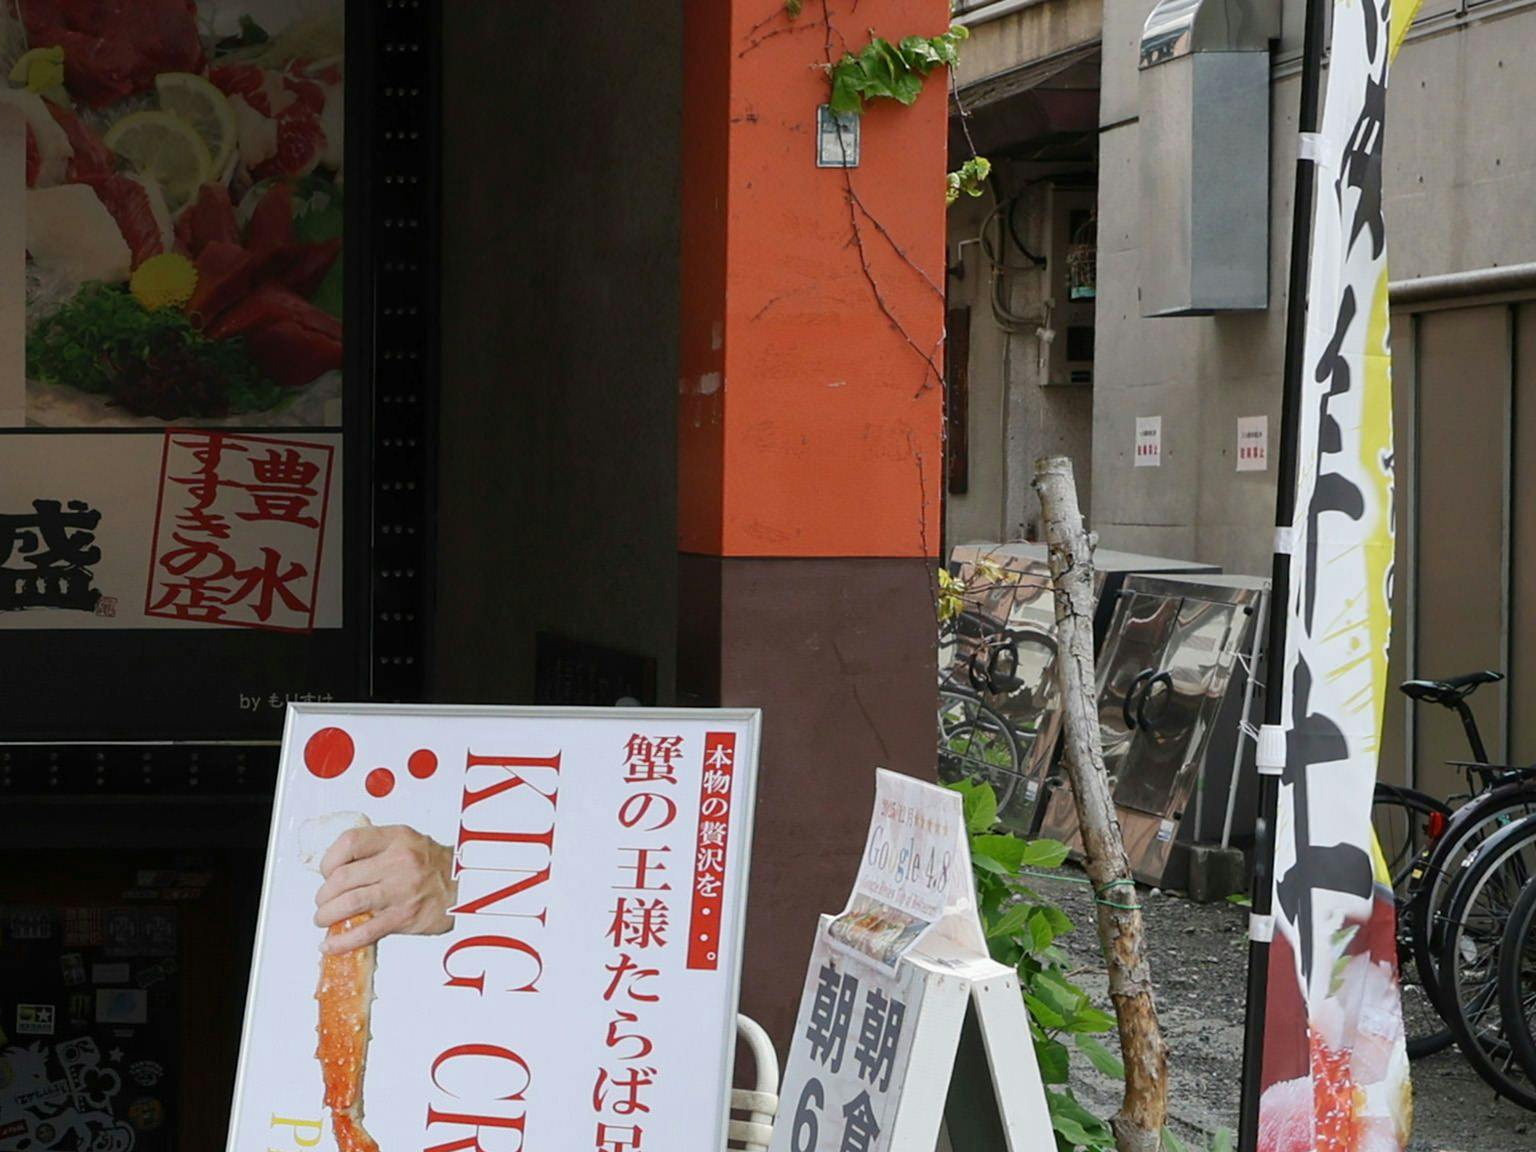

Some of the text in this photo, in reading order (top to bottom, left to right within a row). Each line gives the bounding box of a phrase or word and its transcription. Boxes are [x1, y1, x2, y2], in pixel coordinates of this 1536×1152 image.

[148, 435, 248, 623] すすきの店
[223, 448, 322, 622] 豊水
[239, 693, 261, 712] by
[440, 746, 563, 997] KING
[868, 824, 921, 884] Google
